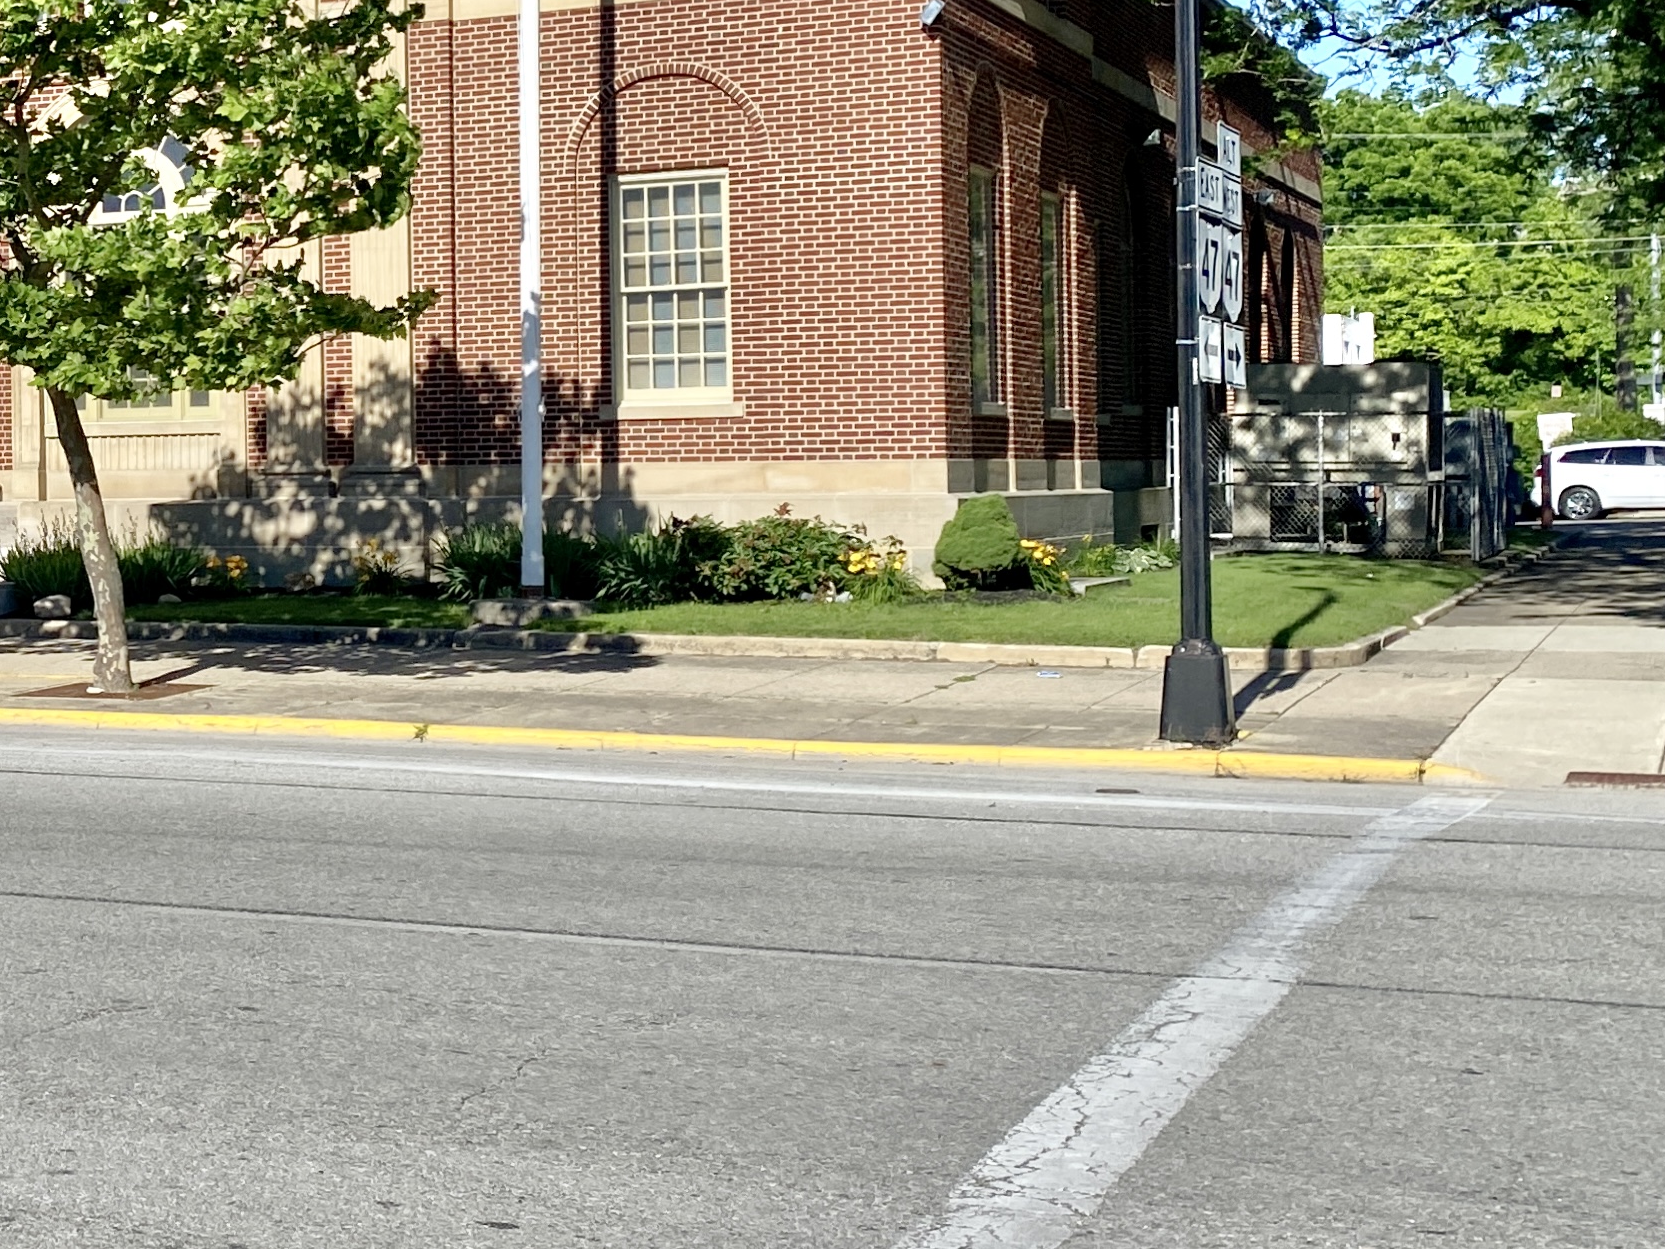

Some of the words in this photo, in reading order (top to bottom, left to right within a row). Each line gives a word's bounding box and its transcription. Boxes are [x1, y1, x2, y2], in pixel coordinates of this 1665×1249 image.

[1200, 166, 1220, 204] EAST
[1202, 238, 1218, 292] 47
[1225, 250, 1240, 302] 47
